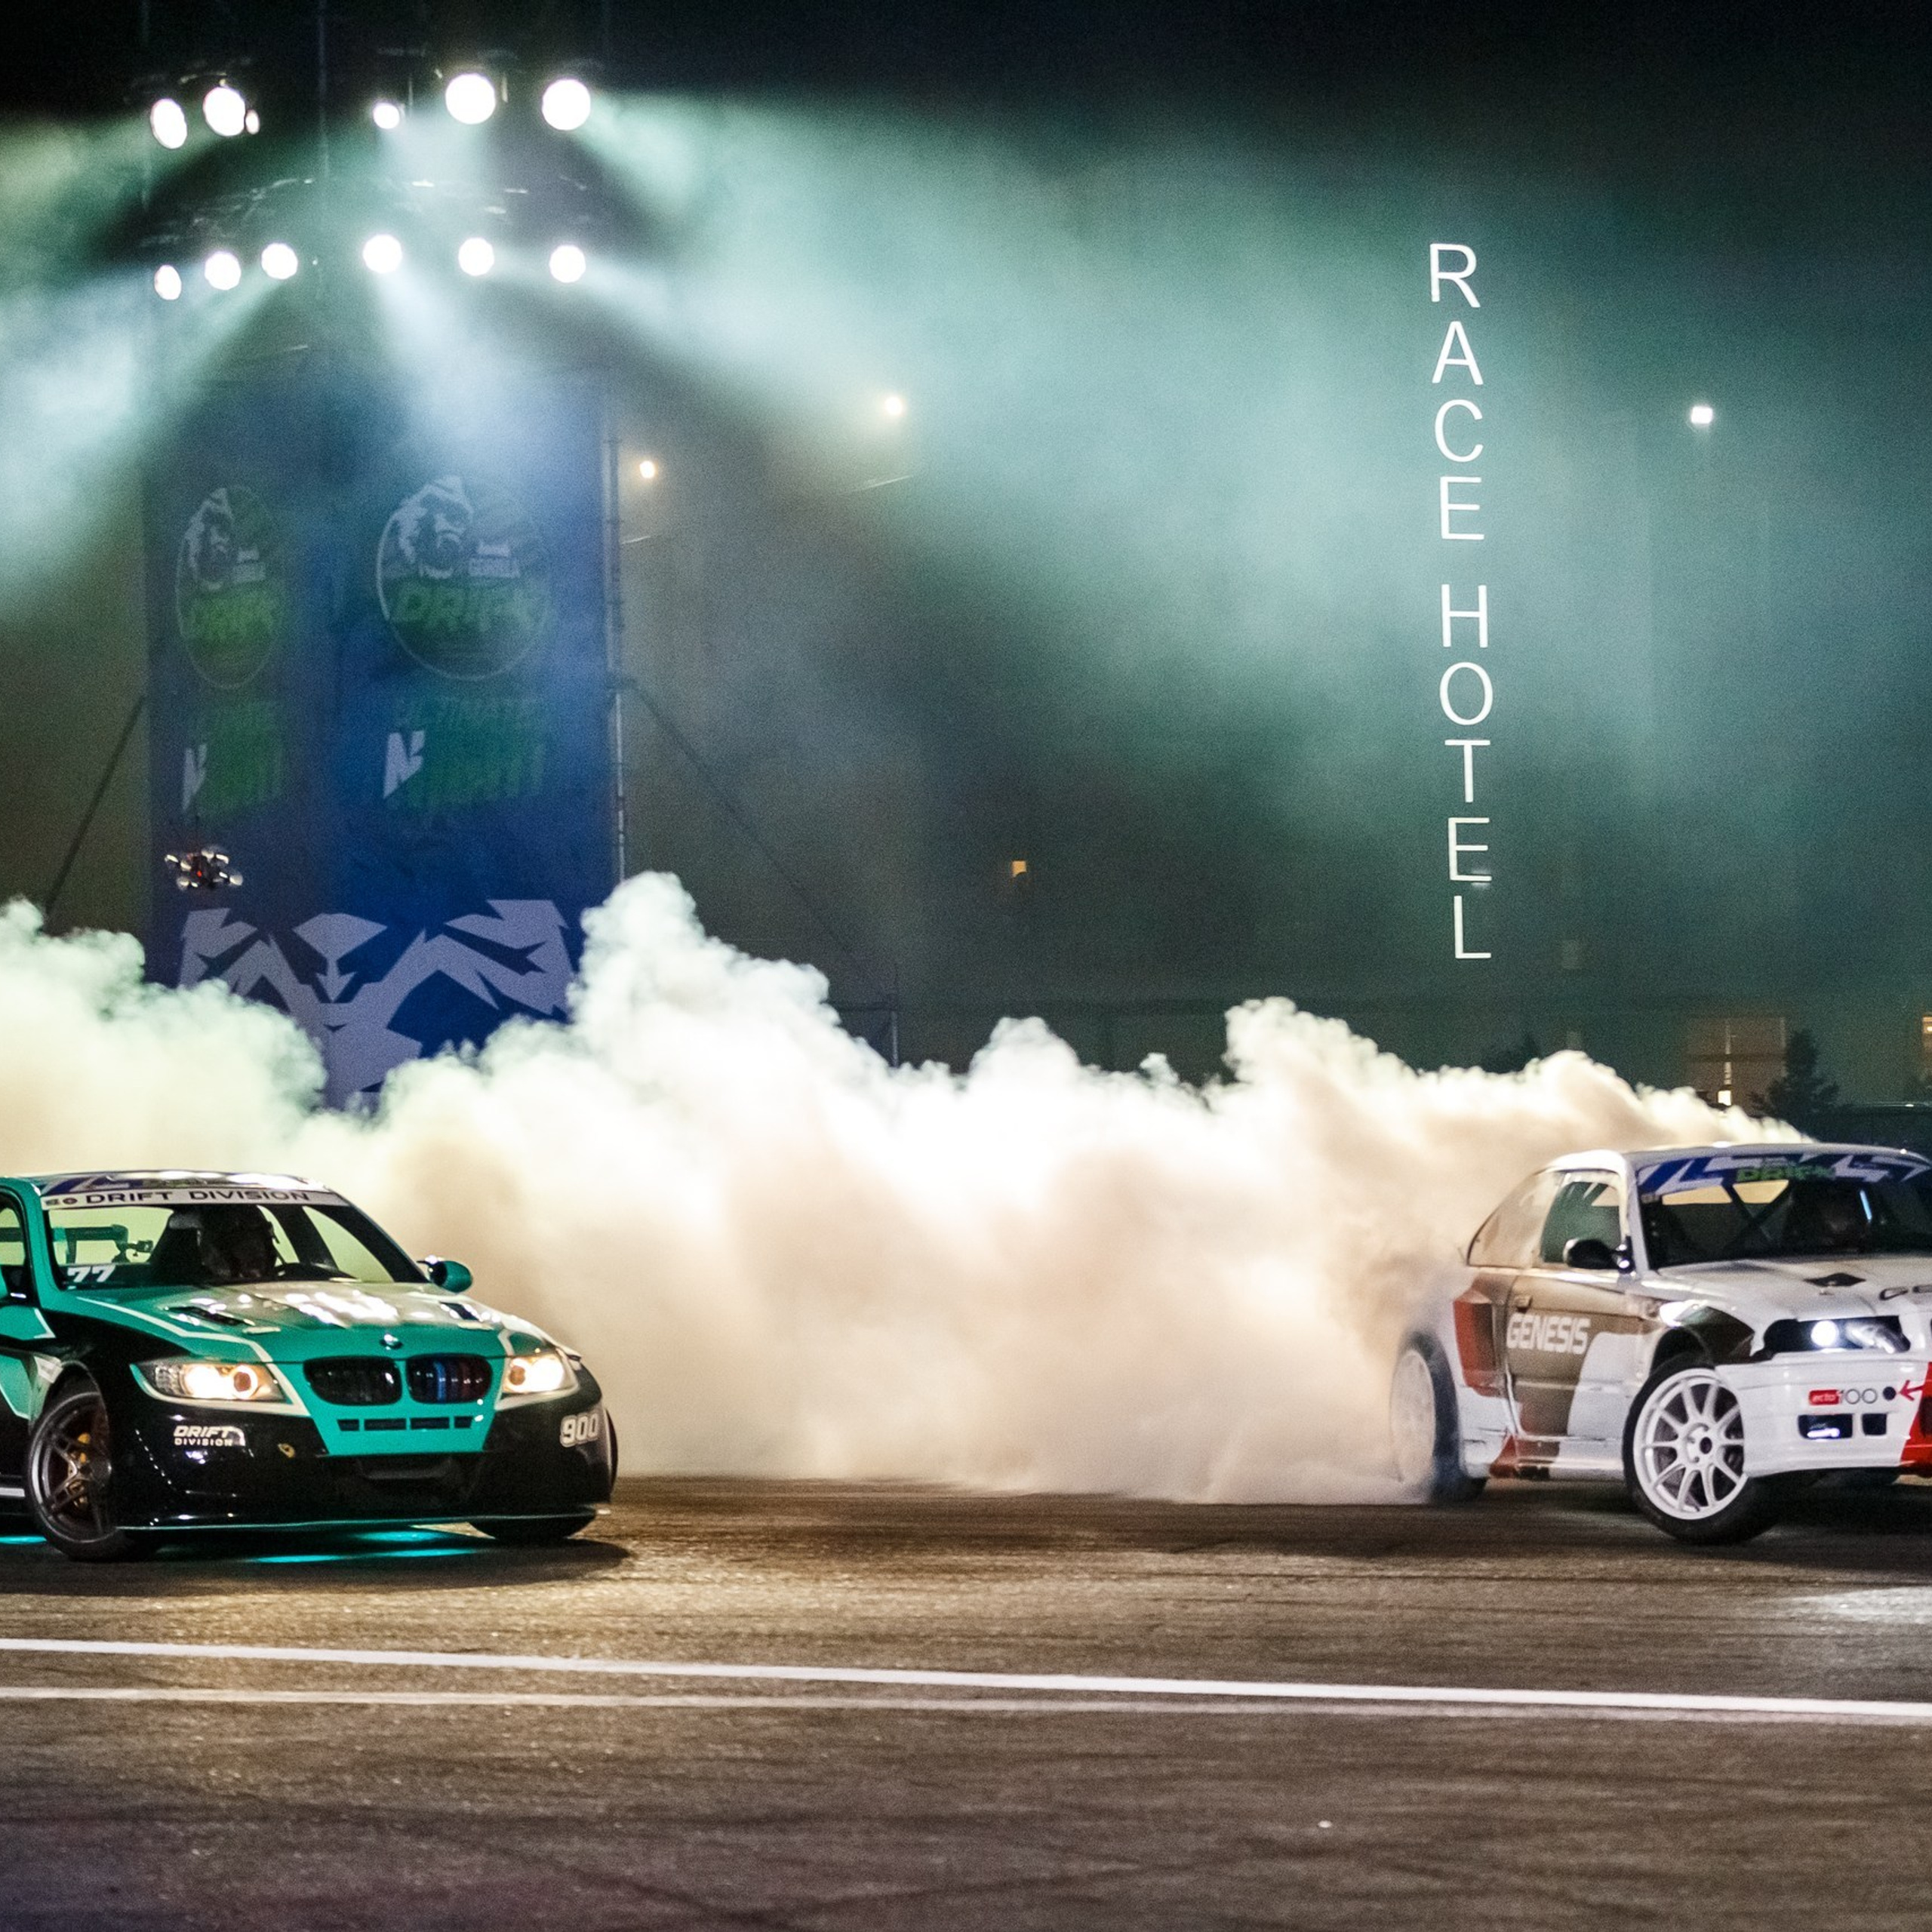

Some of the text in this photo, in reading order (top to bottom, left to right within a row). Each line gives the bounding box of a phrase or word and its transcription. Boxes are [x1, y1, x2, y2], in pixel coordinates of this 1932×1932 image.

[1428, 242, 1494, 960] RACE HOTEL
[85, 1190, 174, 1204] DRIFT
[189, 1189, 311, 1202] DIVISION
[66, 1264, 116, 1283] 77
[1506, 1312, 1591, 1355] GENESIS
[173, 1425, 237, 1438] DRIFT
[559, 1411, 600, 1448] 900
[174, 1438, 233, 1447] DIVISION
